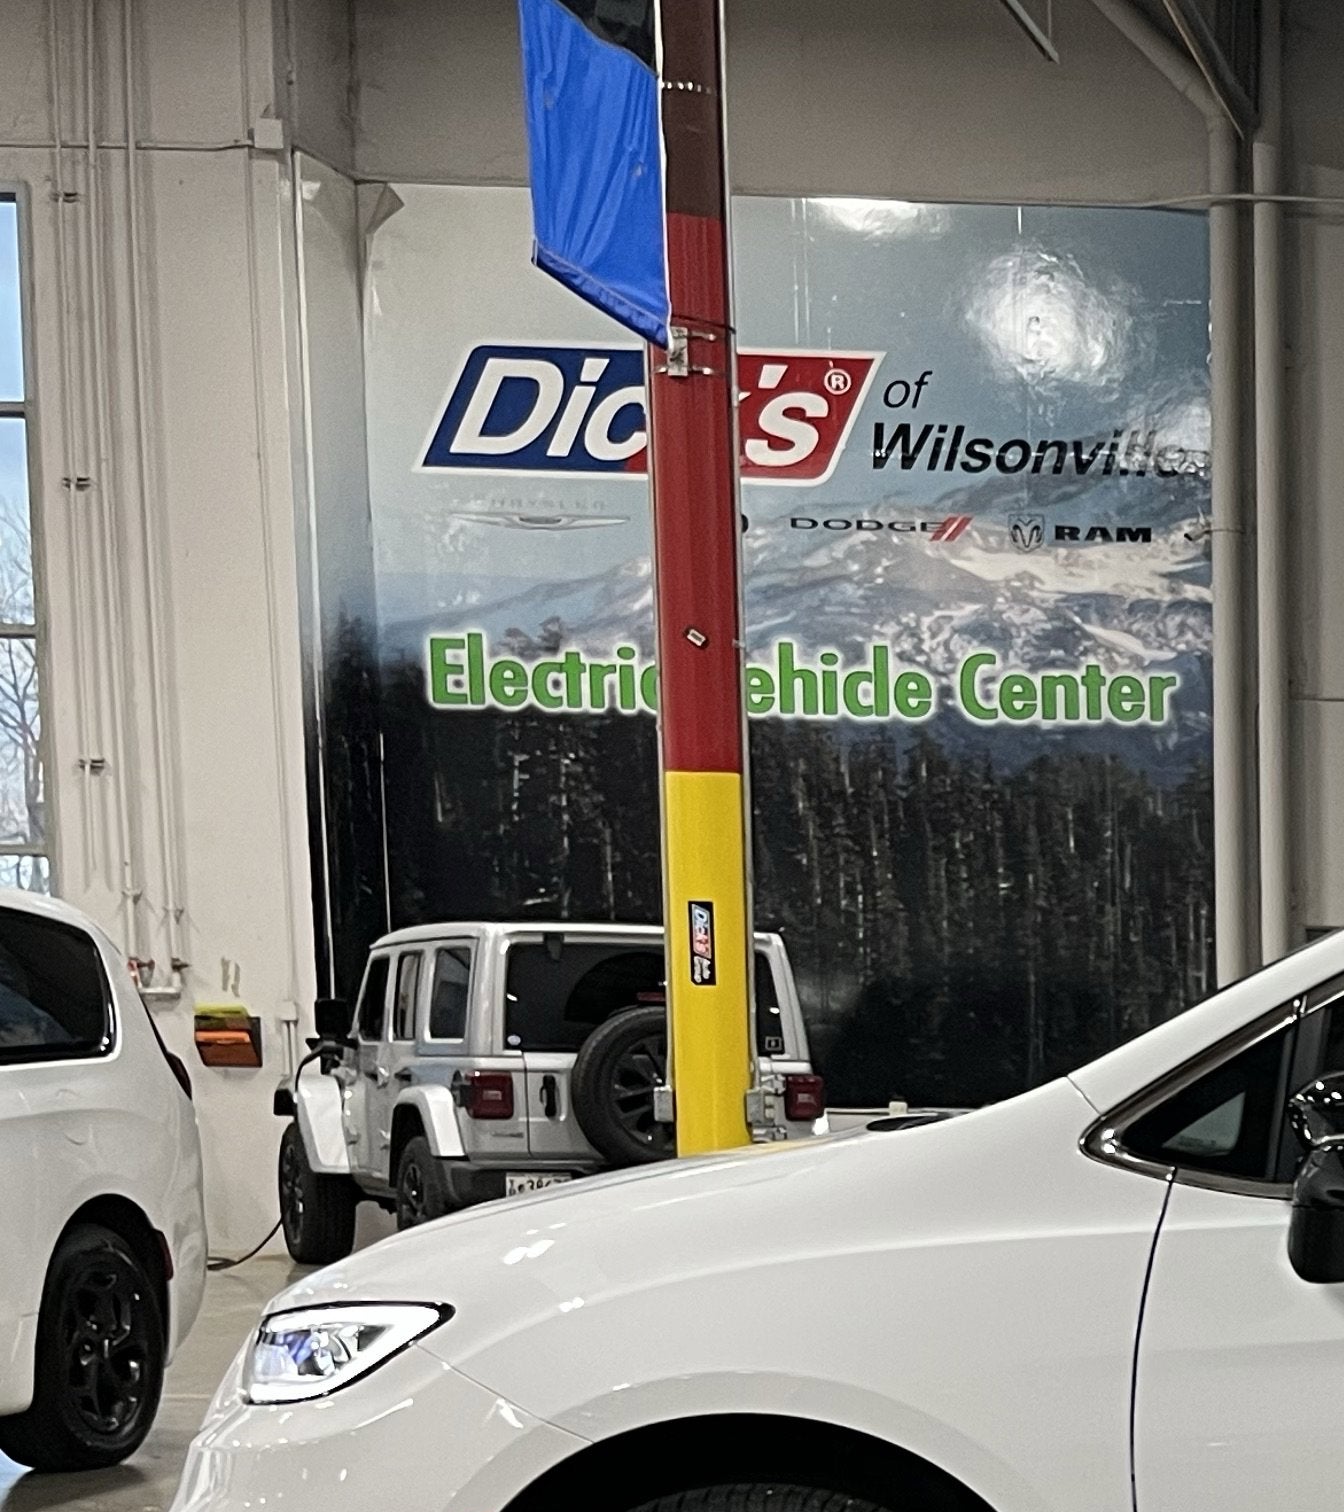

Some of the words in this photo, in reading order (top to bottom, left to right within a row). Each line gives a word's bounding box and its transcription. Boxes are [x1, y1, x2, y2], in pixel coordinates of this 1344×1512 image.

[882, 370, 933, 409] of
[449, 356, 829, 467] Dic's
[790, 516, 944, 533] DODGE
[1053, 524, 1153, 543] RAM
[744, 641, 933, 719] ehicle
[958, 652, 1178, 723] Center
